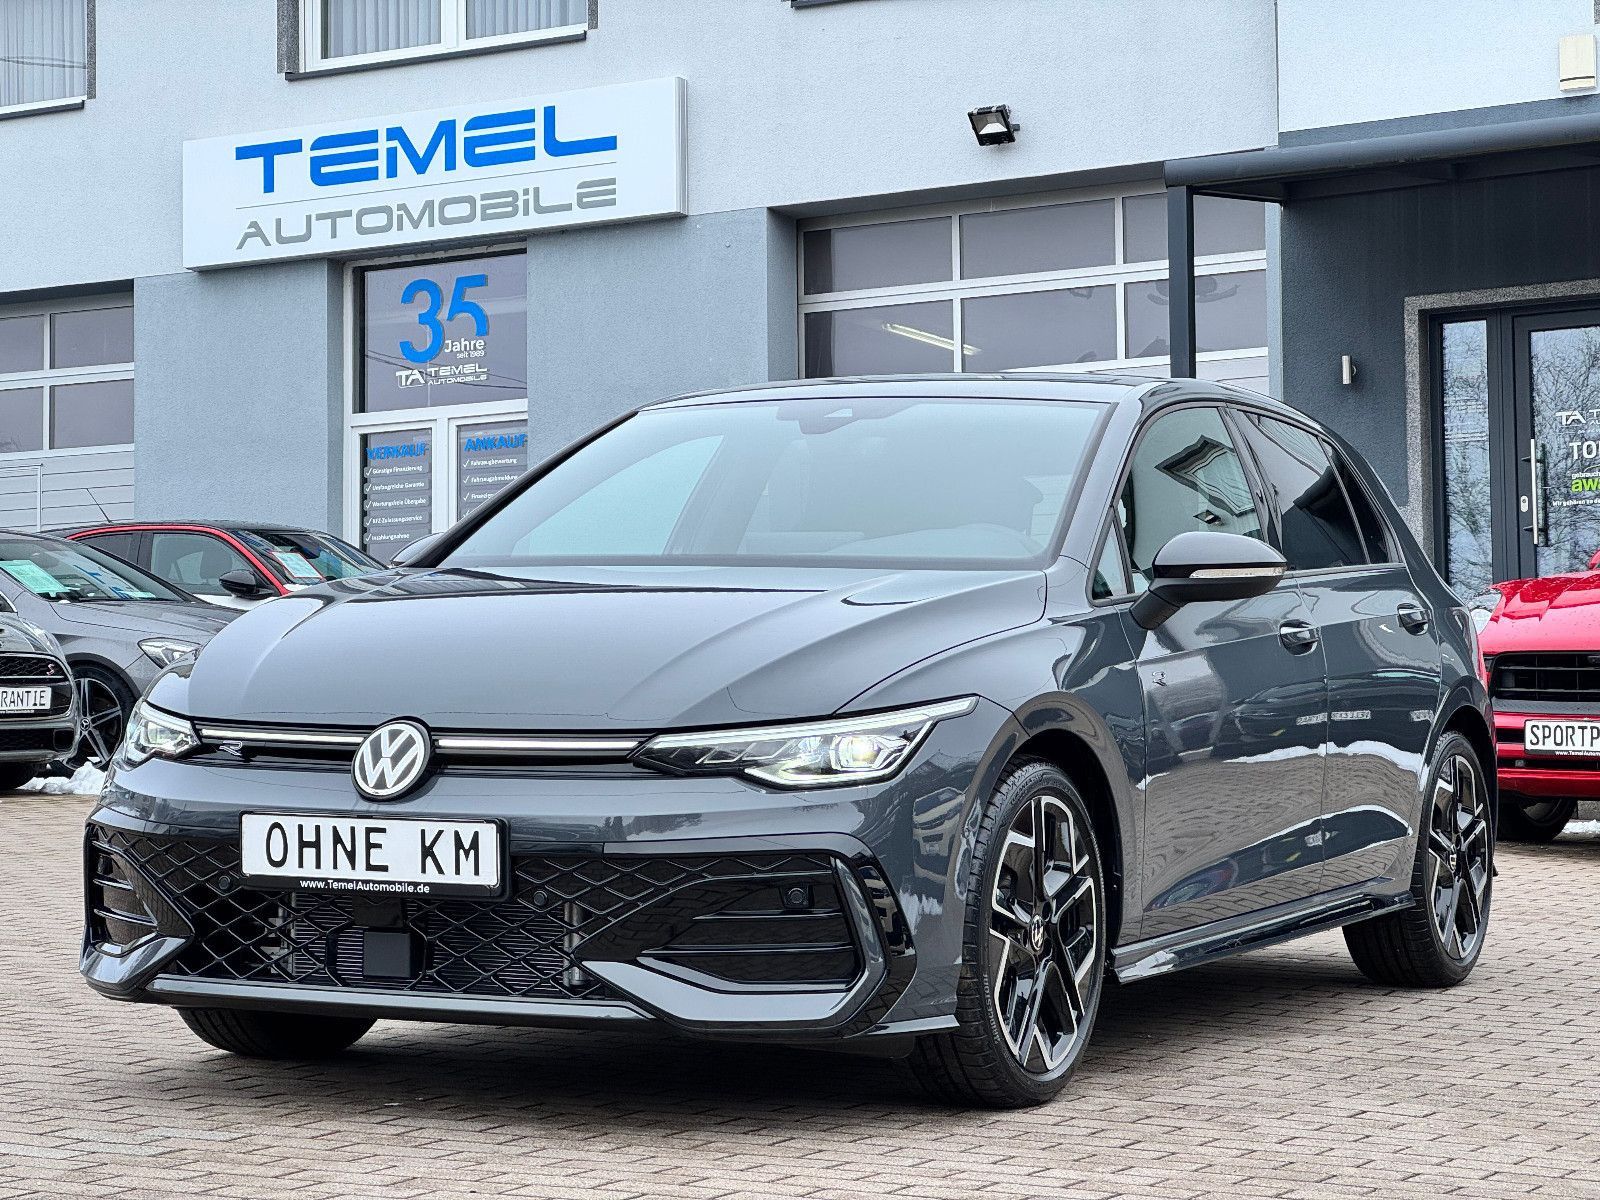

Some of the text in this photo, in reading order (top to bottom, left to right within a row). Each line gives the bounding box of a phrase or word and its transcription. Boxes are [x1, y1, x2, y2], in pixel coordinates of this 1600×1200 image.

[235, 105, 617, 193] TEMEL
[400, 273, 489, 363] 35
[444, 338, 485, 353] Jahre
[456, 351, 468, 359] seit
[395, 369, 426, 386] TA
[427, 363, 488, 377] TEMEL
[1555, 411, 1587, 426] TA
[464, 433, 528, 452] ANKAUF
[366, 442, 429, 460] VERKAUF
[393, 465, 423, 473] Finanzierung
[265, 821, 480, 876] OHNE KM
[300, 879, 430, 894] www.TemelAutomobile.de
